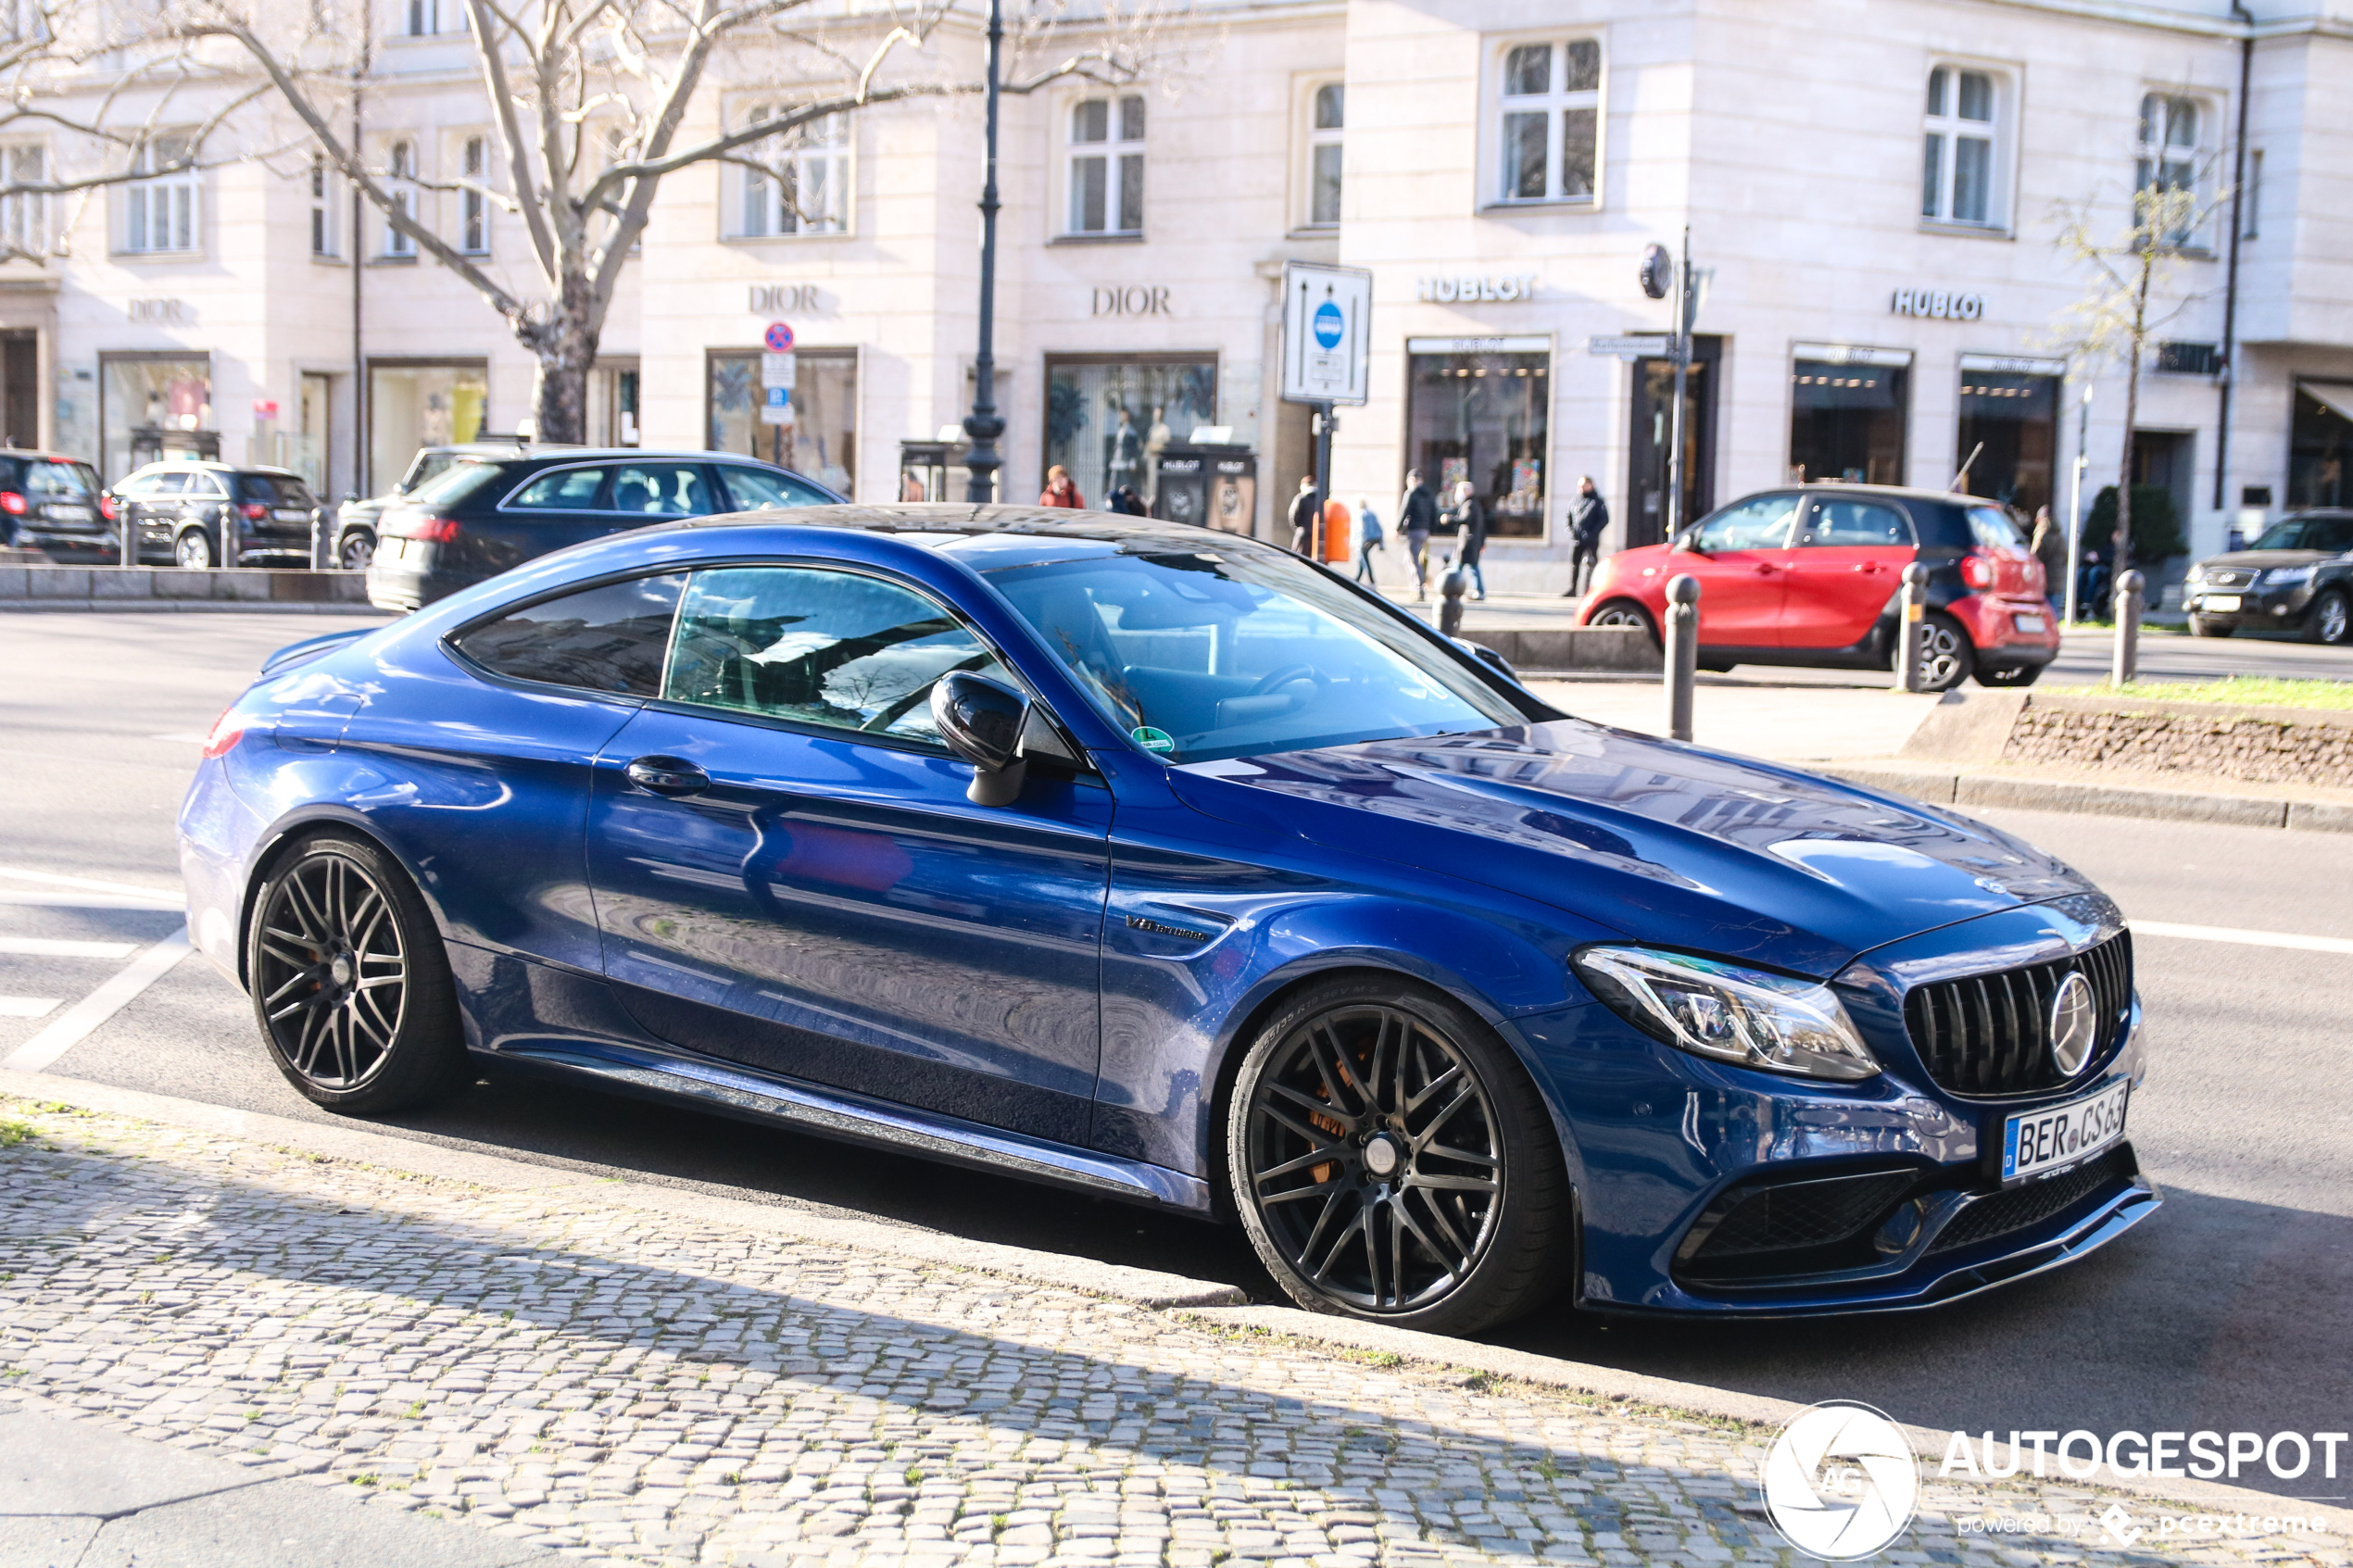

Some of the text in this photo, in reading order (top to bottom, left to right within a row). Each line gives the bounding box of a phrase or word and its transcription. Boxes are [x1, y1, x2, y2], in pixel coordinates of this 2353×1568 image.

[749, 284, 819, 313] DIOR
[1092, 284, 1173, 318] DIOR
[1416, 274, 1536, 302] HUBLOT
[128, 298, 182, 322] DIOR
[1892, 288, 1989, 320] HUBLOT
[1125, 915, 1155, 931] V8
[1258, 1012, 1295, 1058] 255/35
[1297, 997, 1318, 1014] R19
[2018, 1115, 2069, 1167] BER
[2006, 1155, 2012, 1168] D
